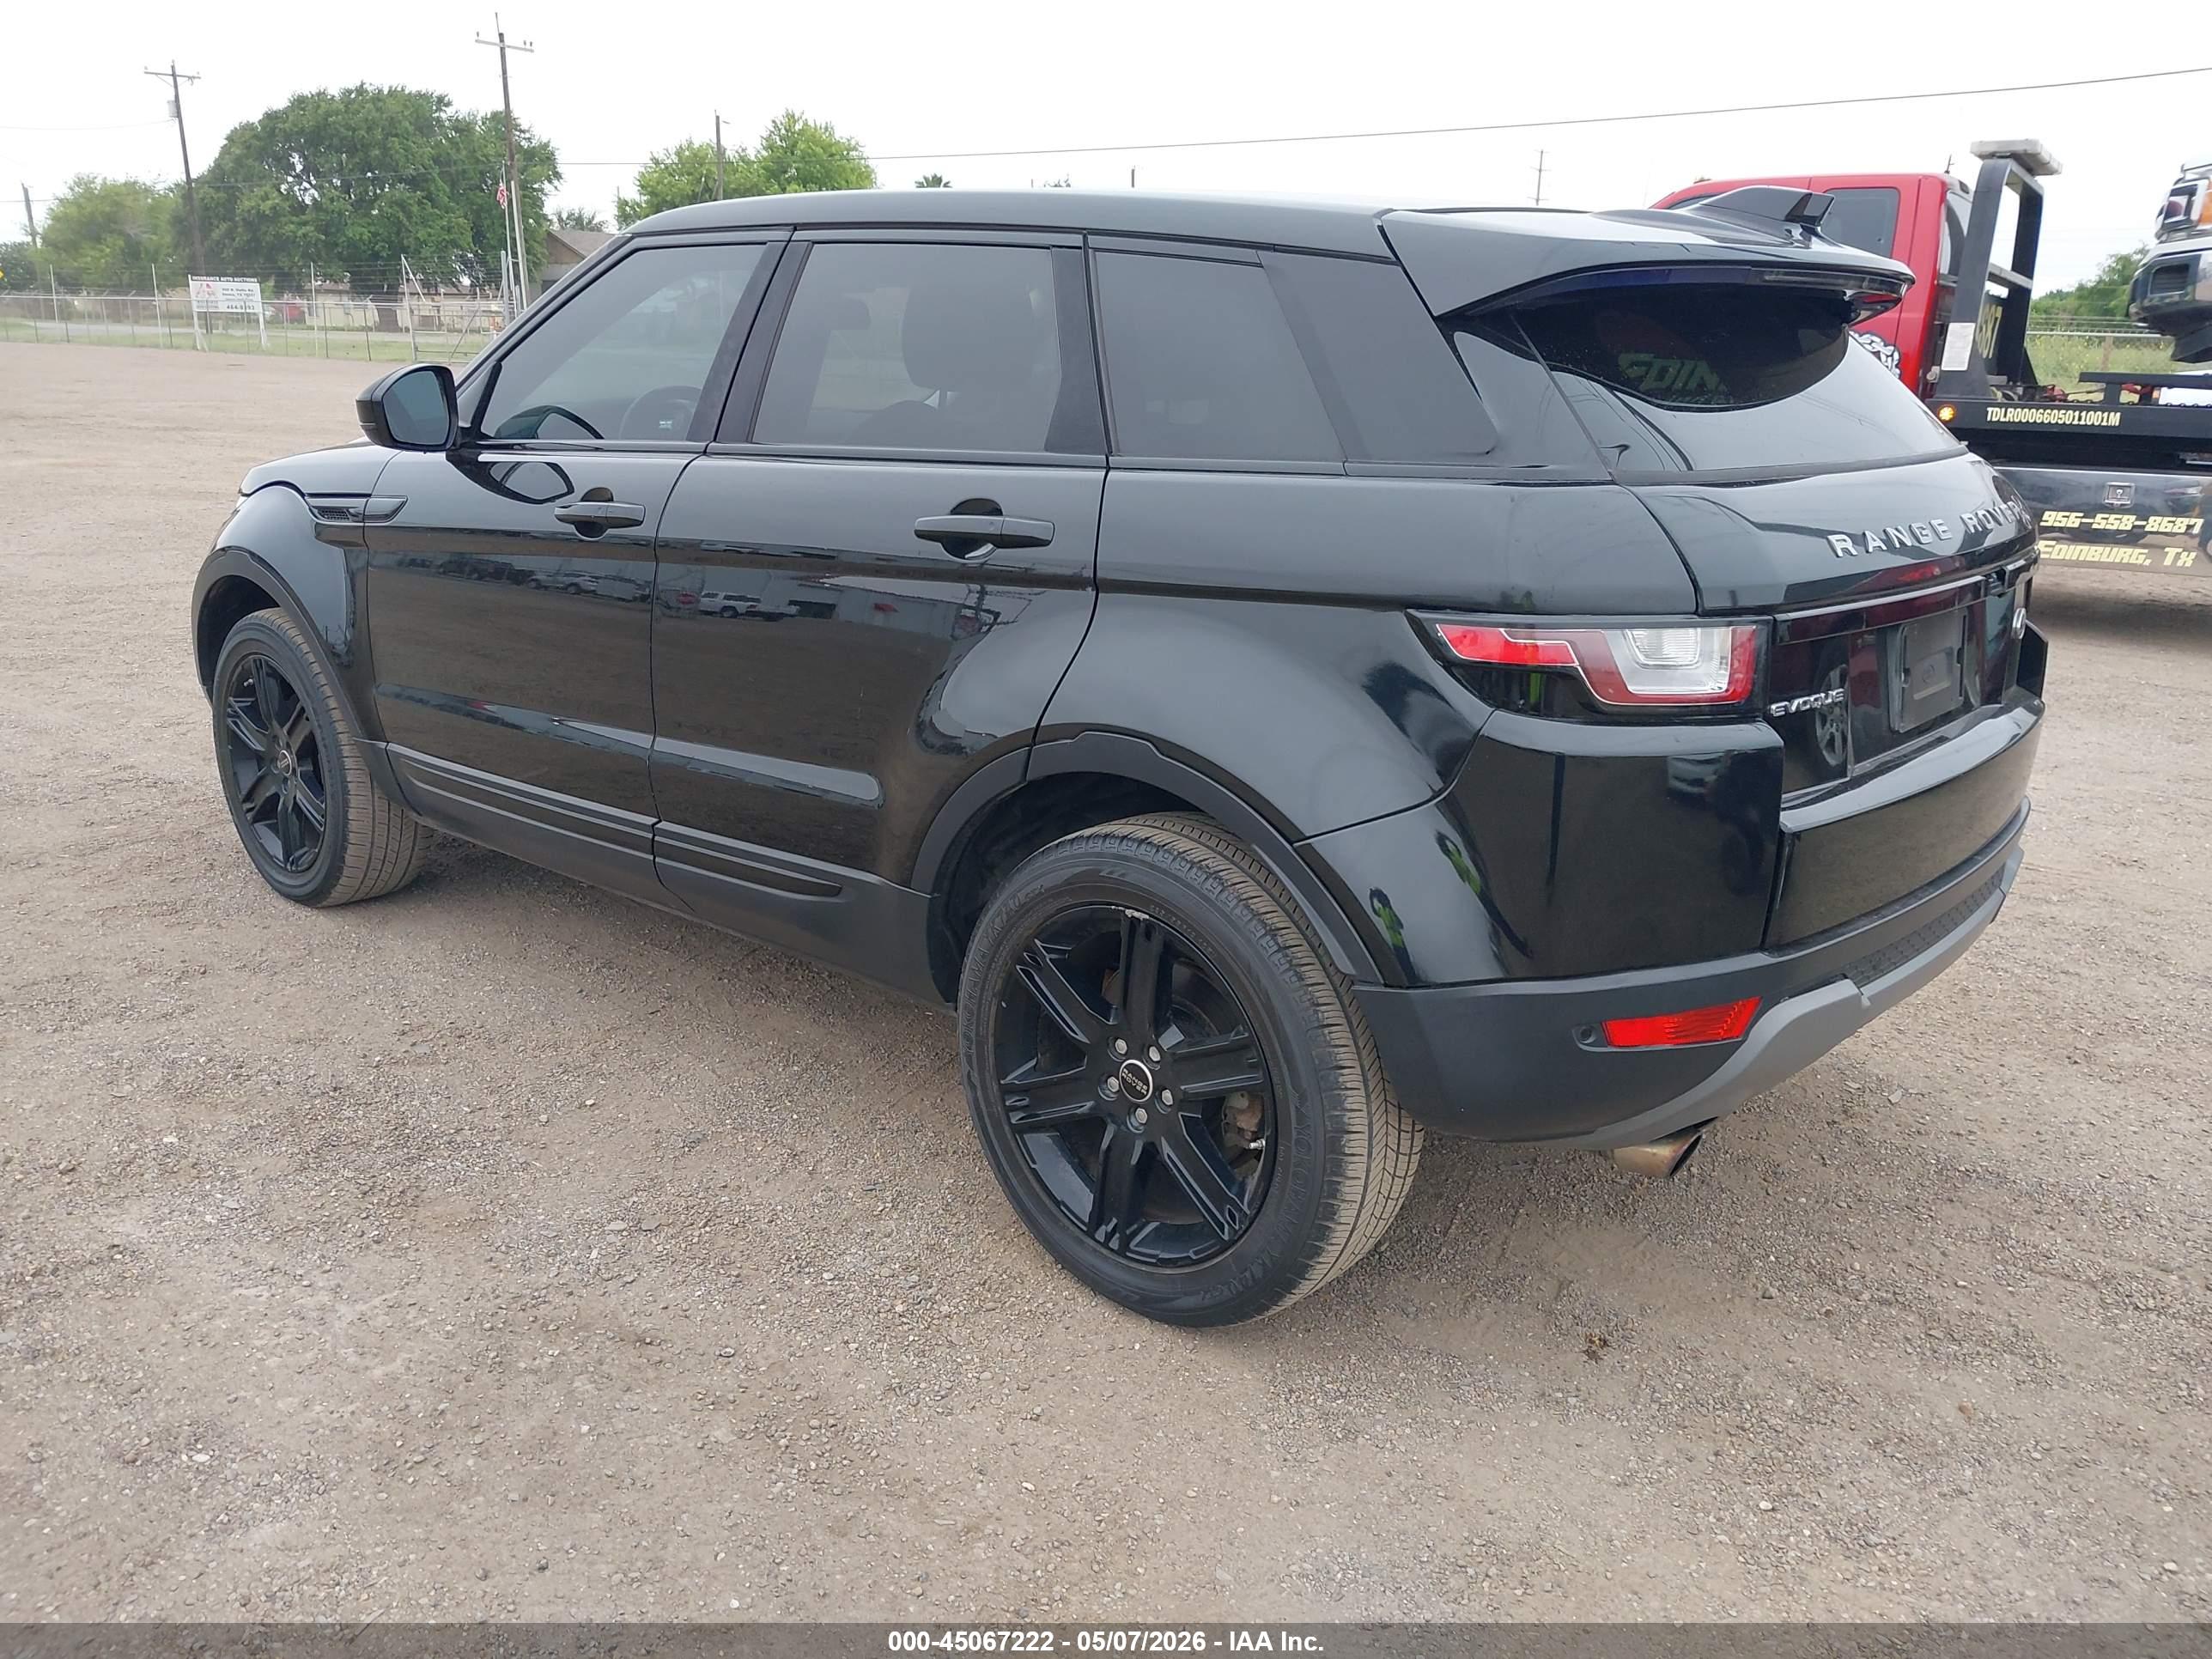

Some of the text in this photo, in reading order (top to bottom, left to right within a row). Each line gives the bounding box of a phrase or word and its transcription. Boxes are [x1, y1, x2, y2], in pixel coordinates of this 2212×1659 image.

[1986, 407, 2121, 427] TDLR0006605011001M
[1826, 495, 2033, 558] RANGE ROVER
[2039, 510, 2205, 534] 956-558-8687
[1770, 688, 1845, 717] EVOQUE
[1121, 1073, 1147, 1096] ROVER
[1122, 1067, 1148, 1091] RANGE
